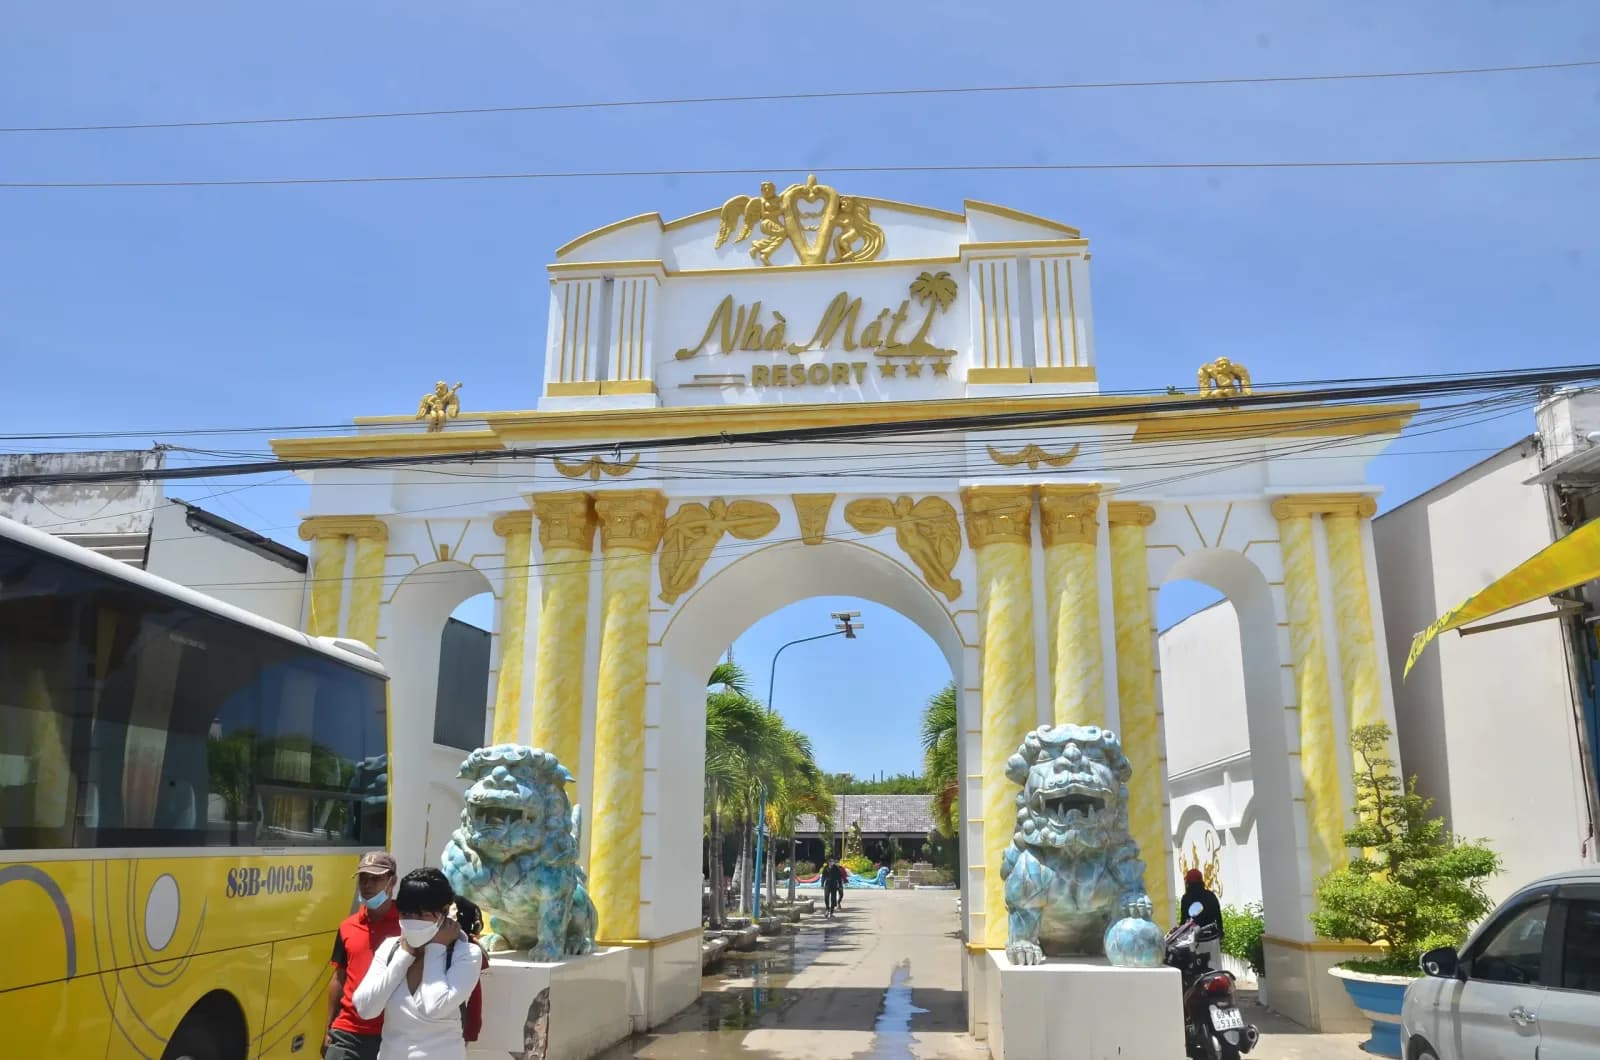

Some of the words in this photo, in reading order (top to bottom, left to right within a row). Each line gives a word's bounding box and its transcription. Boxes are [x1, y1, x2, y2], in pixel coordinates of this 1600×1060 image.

[675, 293, 786, 360] Nhà
[787, 291, 910, 355] Mát
[751, 361, 868, 387] RESORT
[226, 864, 313, 898] 83B-009.95
